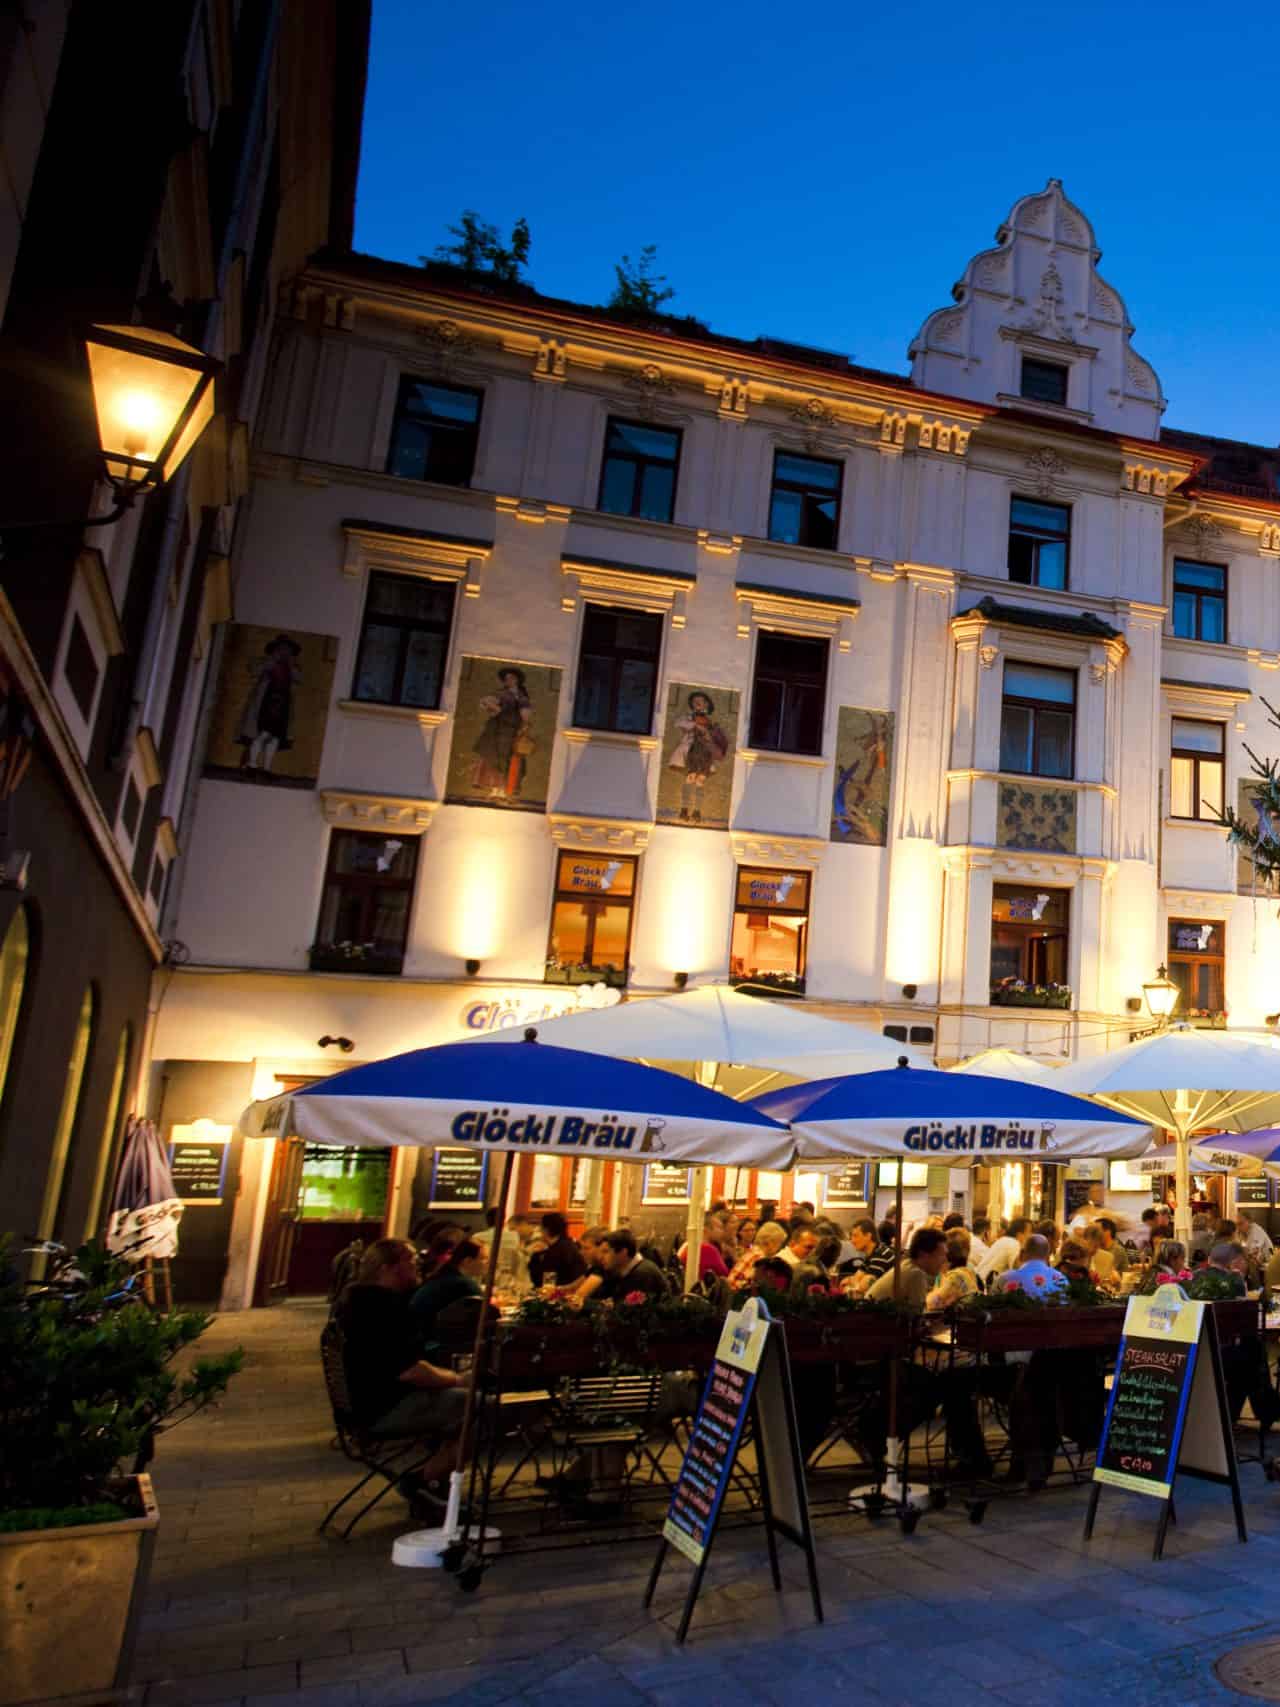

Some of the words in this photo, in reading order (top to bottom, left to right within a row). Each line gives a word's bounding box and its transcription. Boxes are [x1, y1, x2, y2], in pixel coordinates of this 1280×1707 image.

[452, 1108, 556, 1144] Glöckl
[557, 1114, 637, 1150] Bräu
[903, 1122, 976, 1151] Glöckl
[979, 1121, 1035, 1150] Bräu
